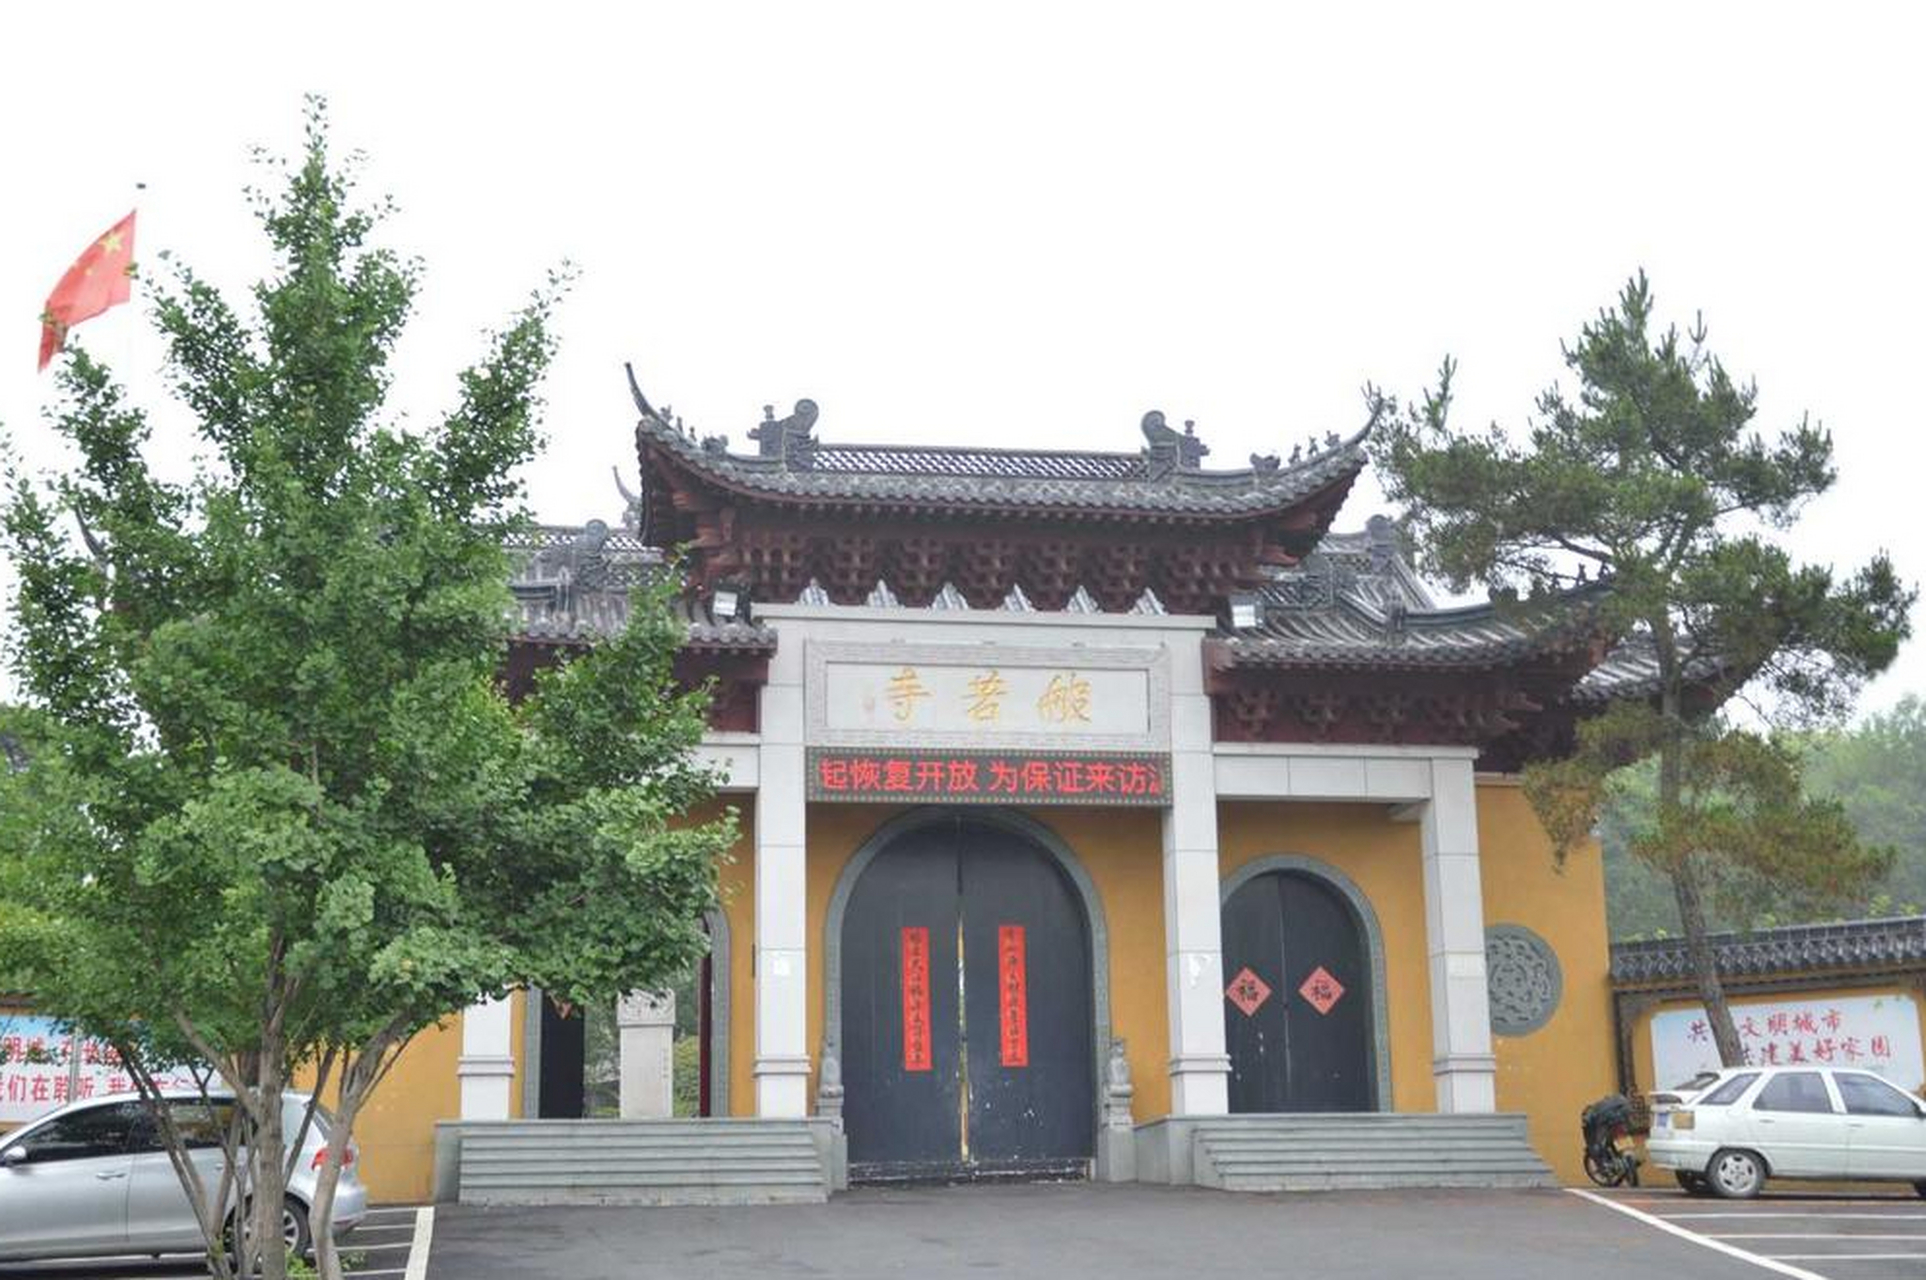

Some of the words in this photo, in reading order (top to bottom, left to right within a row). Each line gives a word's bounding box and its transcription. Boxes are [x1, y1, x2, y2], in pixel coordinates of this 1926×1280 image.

[1687, 1009, 1842, 1043] 共文明城市
